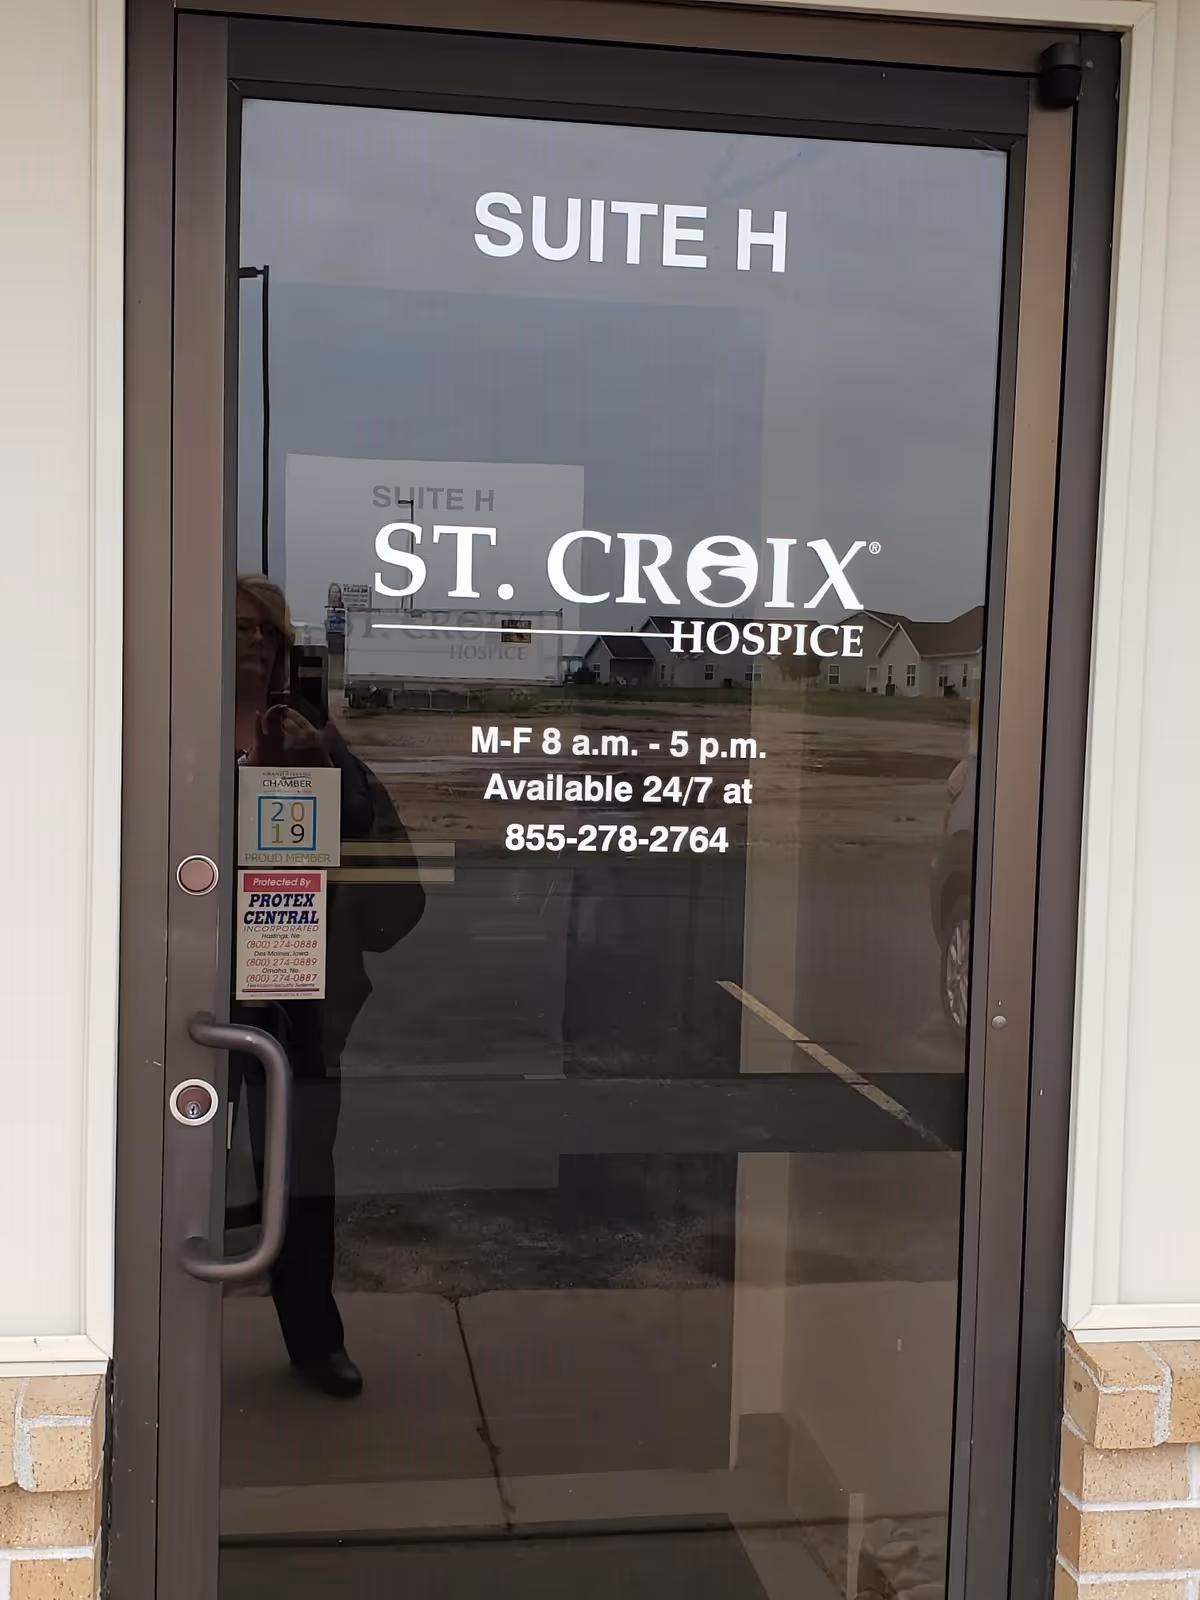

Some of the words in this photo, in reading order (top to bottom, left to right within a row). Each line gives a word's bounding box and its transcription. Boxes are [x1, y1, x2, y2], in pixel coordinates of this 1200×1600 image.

[474, 191, 707, 269] SUITE
[736, 208, 788, 273] H
[372, 485, 464, 510] SUITE
[475, 489, 494, 511] H
[374, 522, 515, 600] ST.
[669, 620, 864, 658] HOSPICE
[449, 644, 528, 661] HOSPICE
[471, 726, 532, 754] M-F
[541, 727, 562, 755] 8
[572, 733, 638, 756] a.m.
[649, 742, 660, 751] -
[669, 730, 689, 758] 5
[700, 736, 766, 764] p.m.
[262, 779, 312, 788] CHAMBER
[483, 773, 633, 803] Available
[642, 776, 713, 807] 24/7
[723, 777, 753, 804] at
[505, 823, 729, 853] 855-278-2764
[245, 852, 283, 863] PROUD
[285, 853, 331, 863] MEMBER
[253, 877, 298, 887] Protected
[299, 877, 311, 888] By
[248, 893, 316, 908] PROTEX
[243, 910, 319, 925] CENTRAL
[243, 925, 319, 933] INCORPORATED
[246, 940, 271, 950] (800)
[272, 940, 318, 949] 274-0888
[246, 958, 271, 967] (800)
[272, 957, 318, 966] 274-0889
[246, 974, 271, 983] (800)
[272, 973, 318, 982] 274-0887
